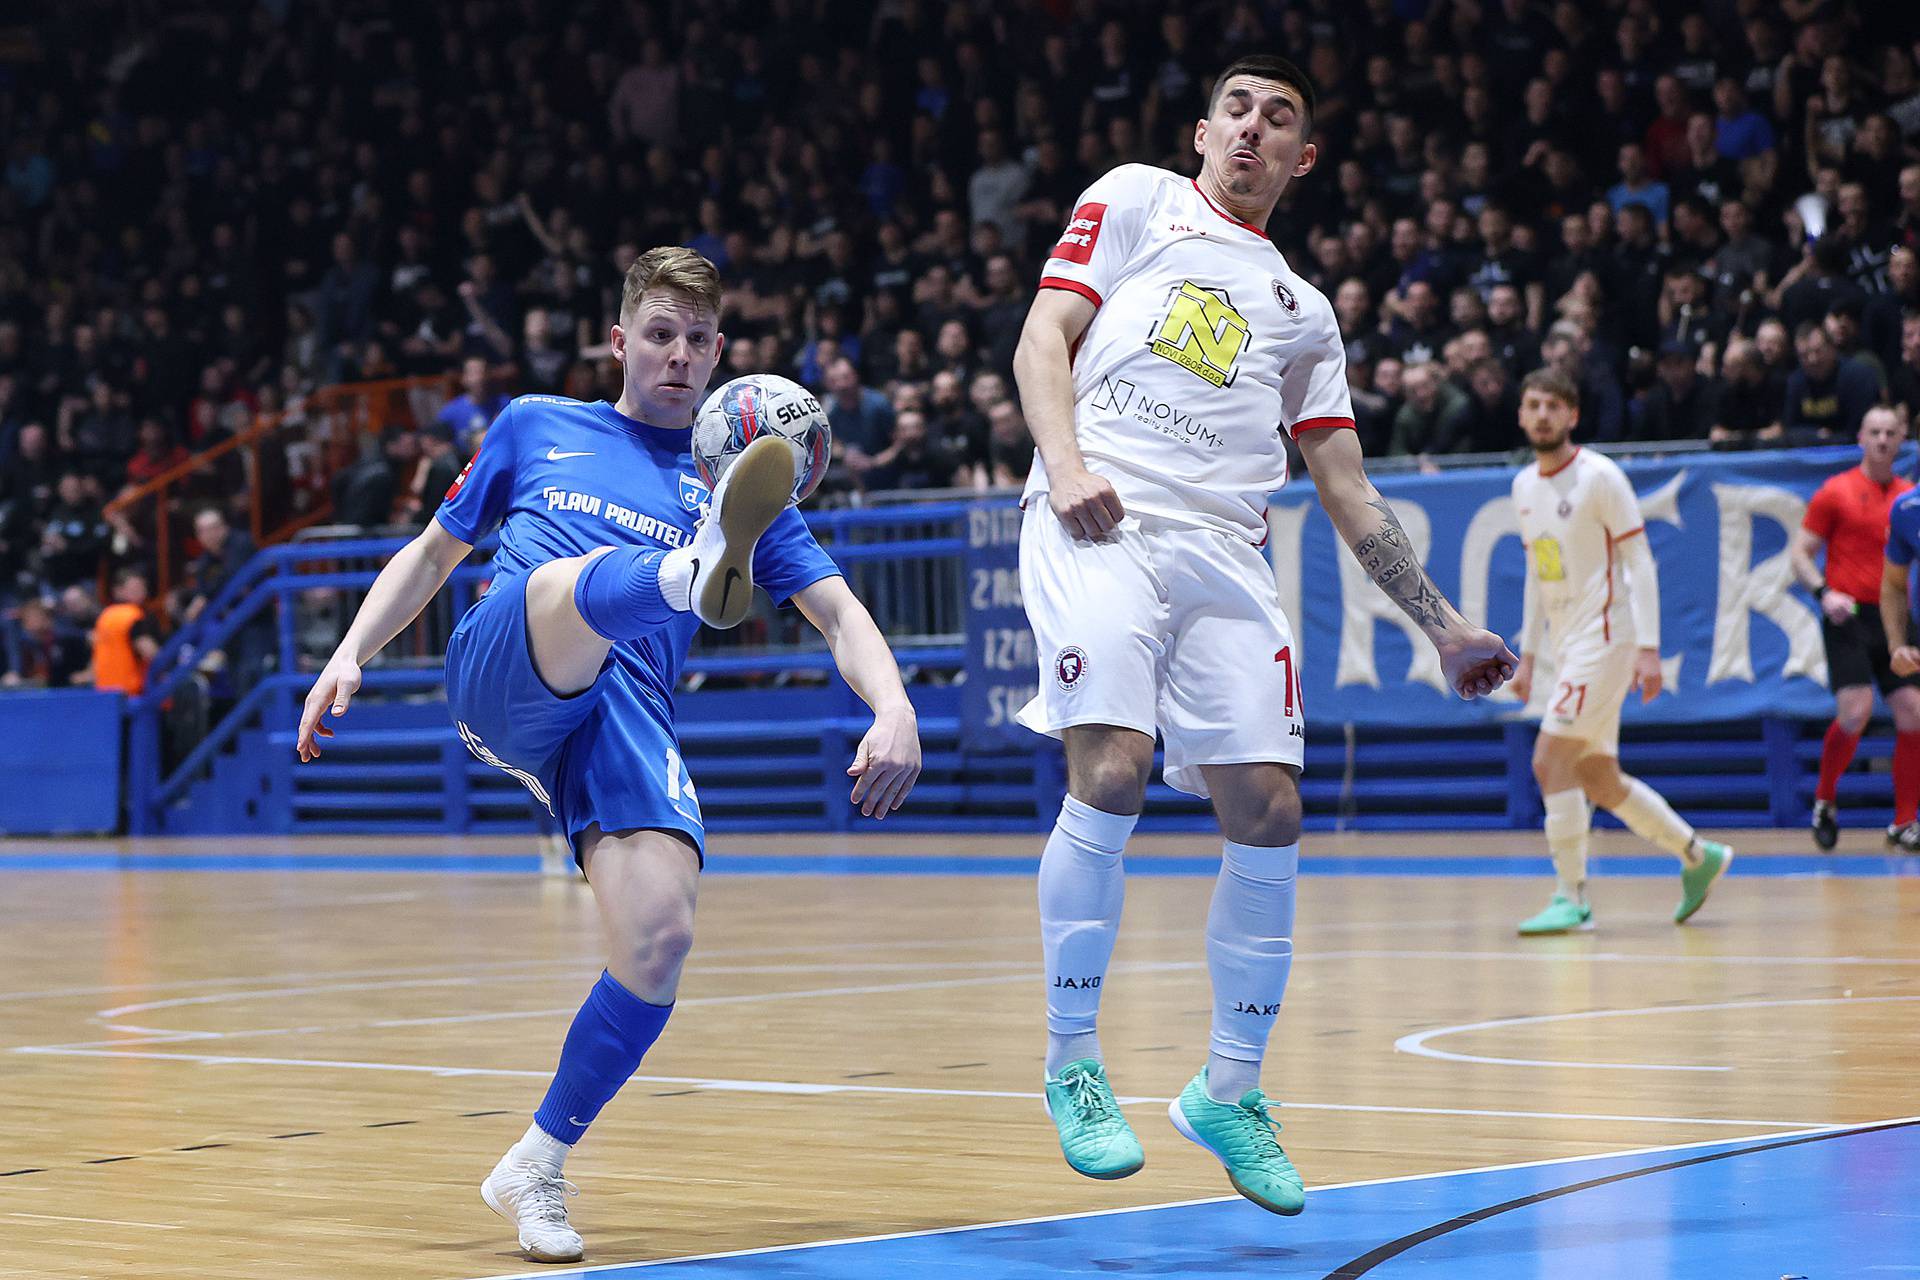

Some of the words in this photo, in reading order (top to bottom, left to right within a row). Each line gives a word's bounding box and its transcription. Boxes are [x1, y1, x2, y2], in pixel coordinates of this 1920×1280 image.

[1156, 343, 1180, 358] NOVI
[1180, 353, 1203, 374] IZBOR
[1133, 412, 1162, 431] realty
[1162, 426, 1192, 445] group
[547, 490, 602, 516] PLAVI
[1274, 645, 1305, 719] 1
[1553, 682, 1587, 716] 21
[1053, 975, 1102, 990] JAKO
[1233, 1001, 1281, 1016] JAKO
